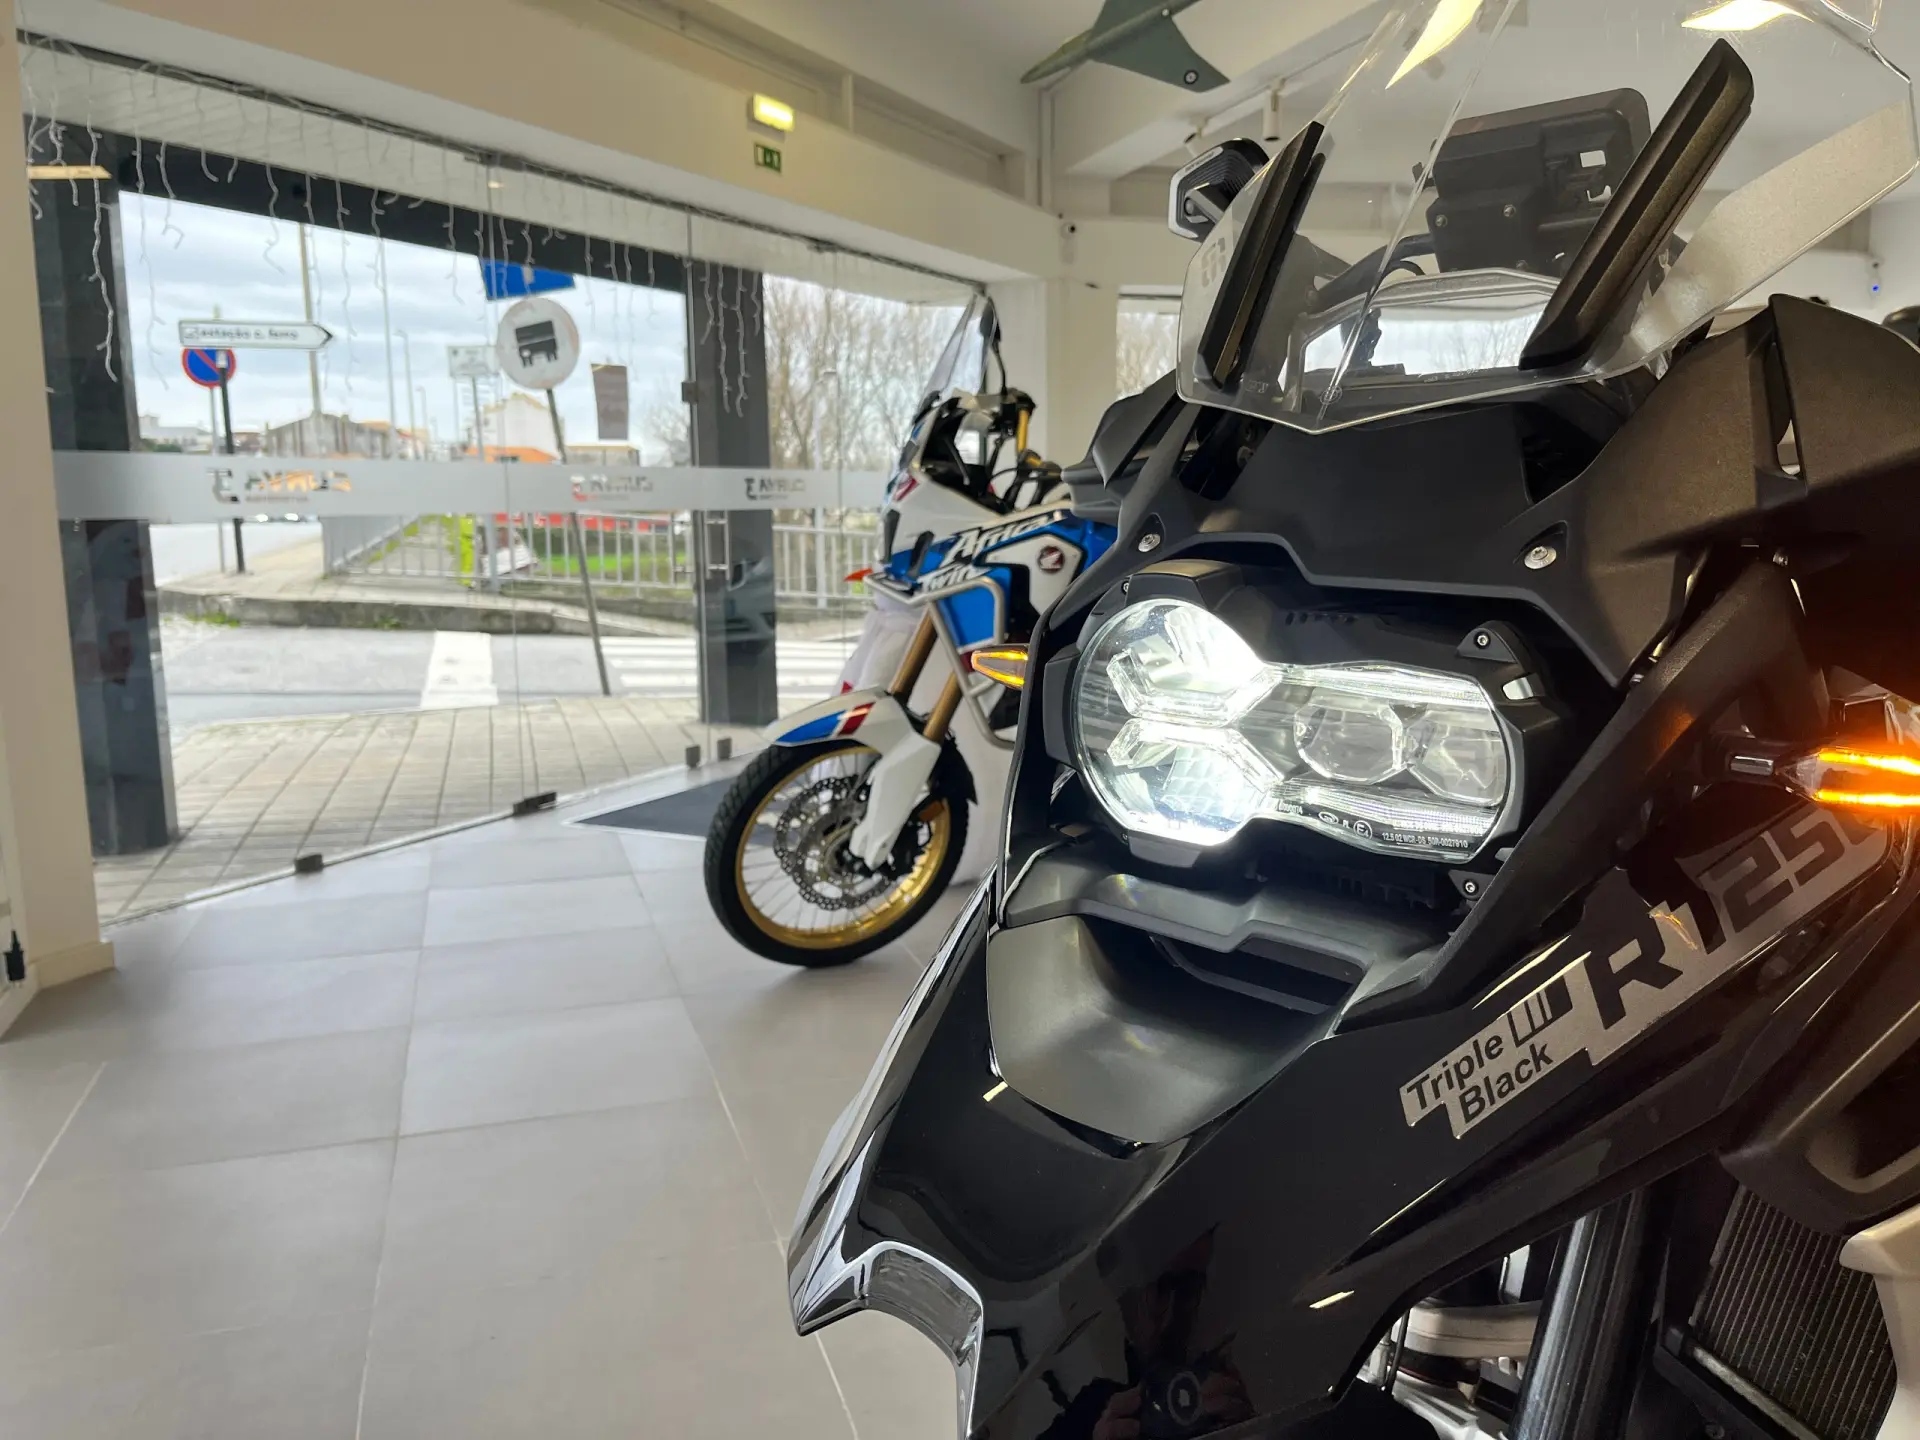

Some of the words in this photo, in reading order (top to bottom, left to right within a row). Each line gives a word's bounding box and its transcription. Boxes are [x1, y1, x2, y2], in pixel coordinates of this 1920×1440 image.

[939, 514, 1052, 569] Africa
[916, 561, 990, 594] Twin
[1406, 1034, 1504, 1110] Triple
[1458, 1042, 1554, 1125] Black
